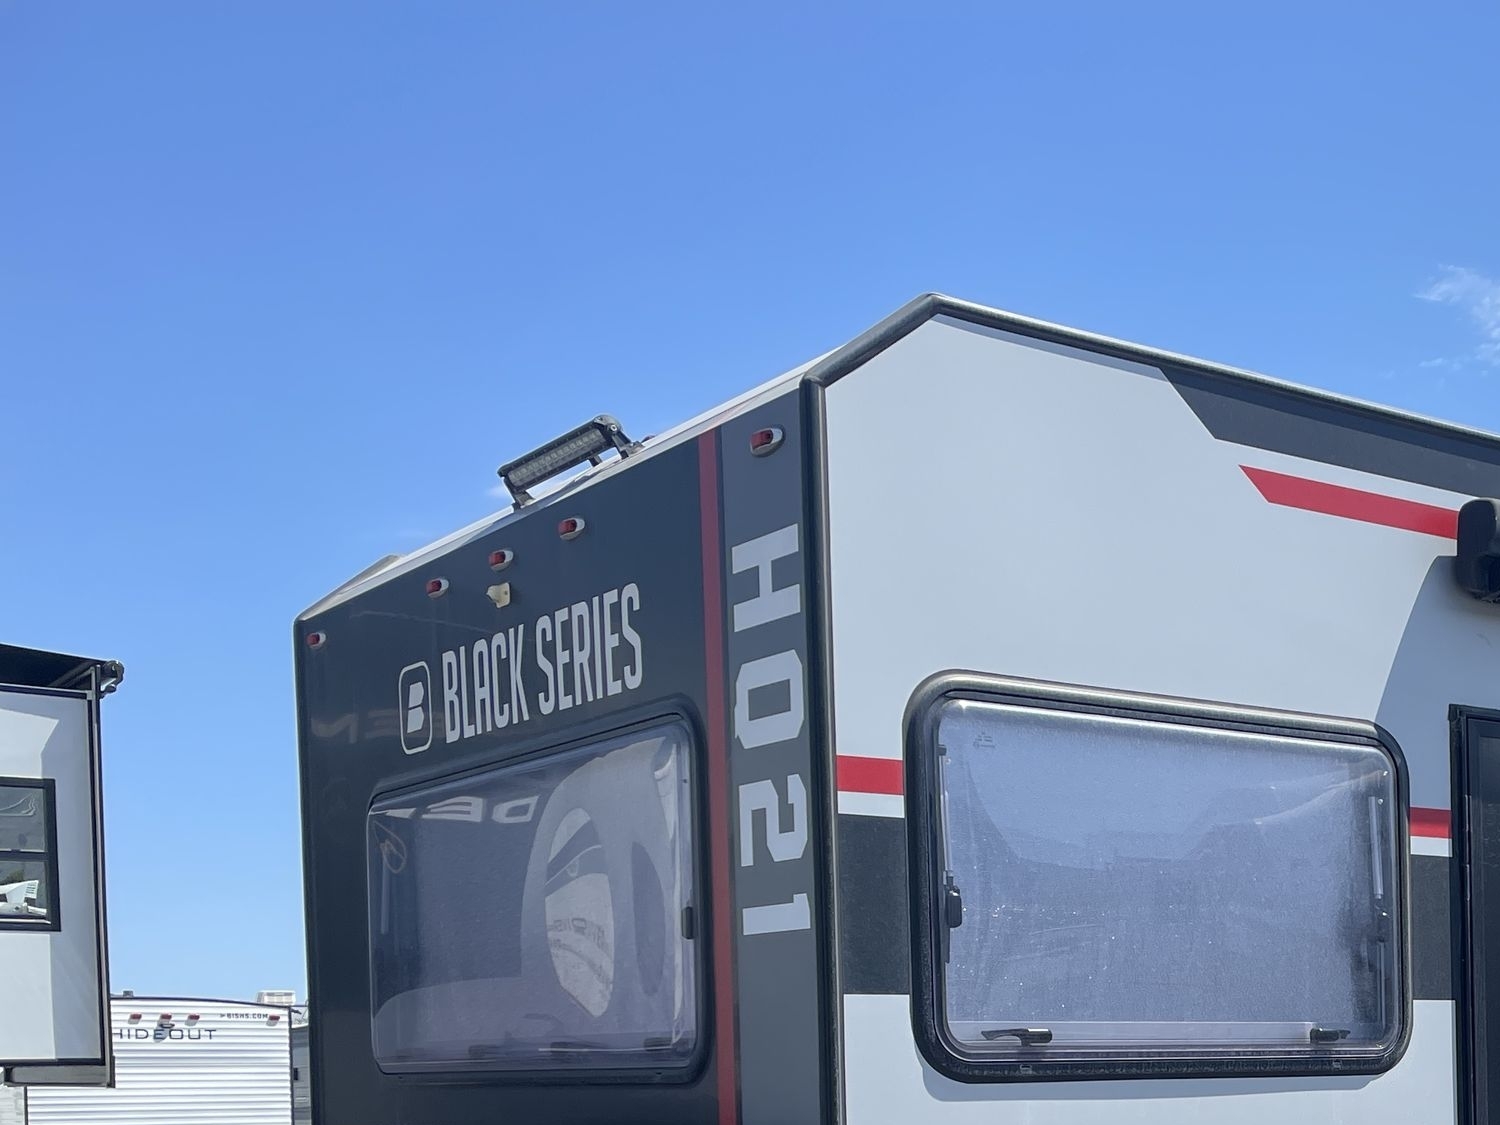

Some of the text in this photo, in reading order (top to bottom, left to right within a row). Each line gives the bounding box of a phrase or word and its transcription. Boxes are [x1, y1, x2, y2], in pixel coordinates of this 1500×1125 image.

[442, 623, 530, 744] BLACK
[536, 583, 642, 715] SERIES
[731, 522, 811, 937] HQ21
